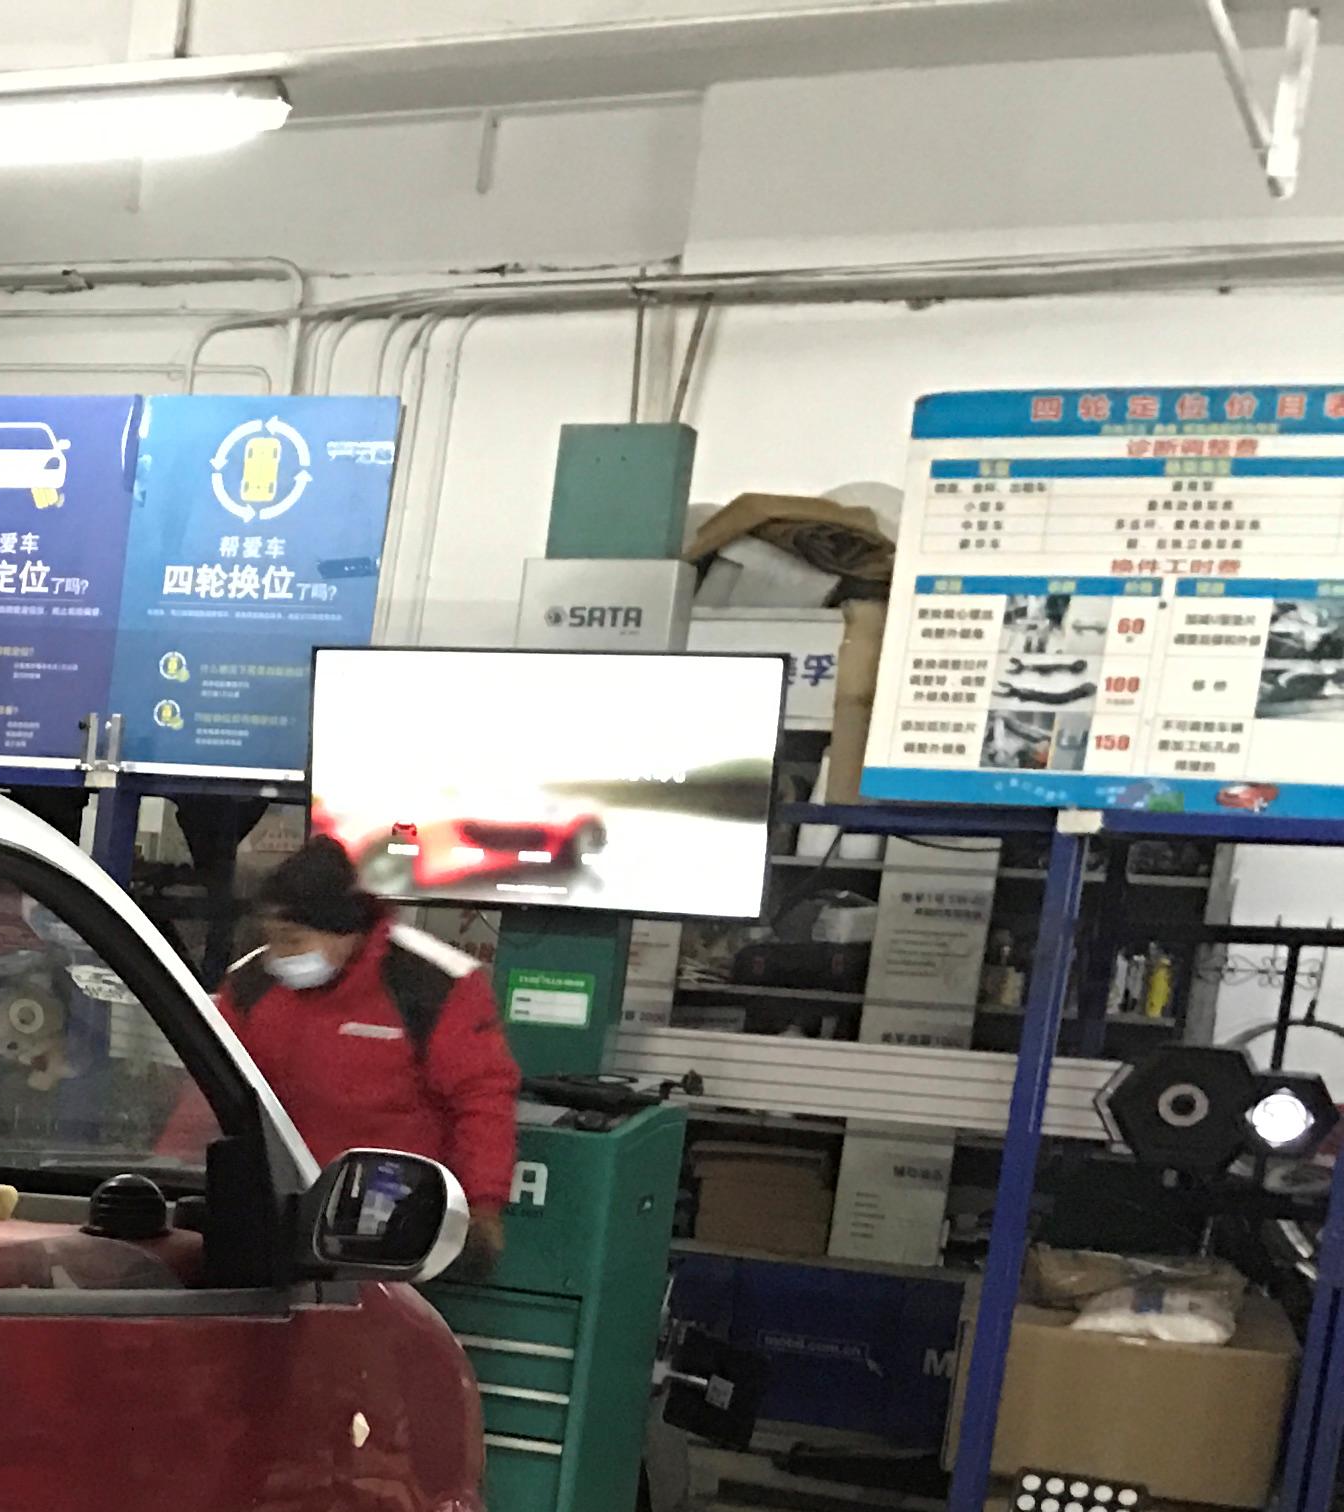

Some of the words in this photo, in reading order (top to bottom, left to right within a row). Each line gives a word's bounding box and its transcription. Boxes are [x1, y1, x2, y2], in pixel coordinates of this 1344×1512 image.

[219, 535, 286, 559] 帮爱车
[569, 606, 643, 628] SATA
[1117, 618, 1145, 634] 60
[1105, 676, 1140, 693] 100
[1094, 735, 1131, 751] 150
